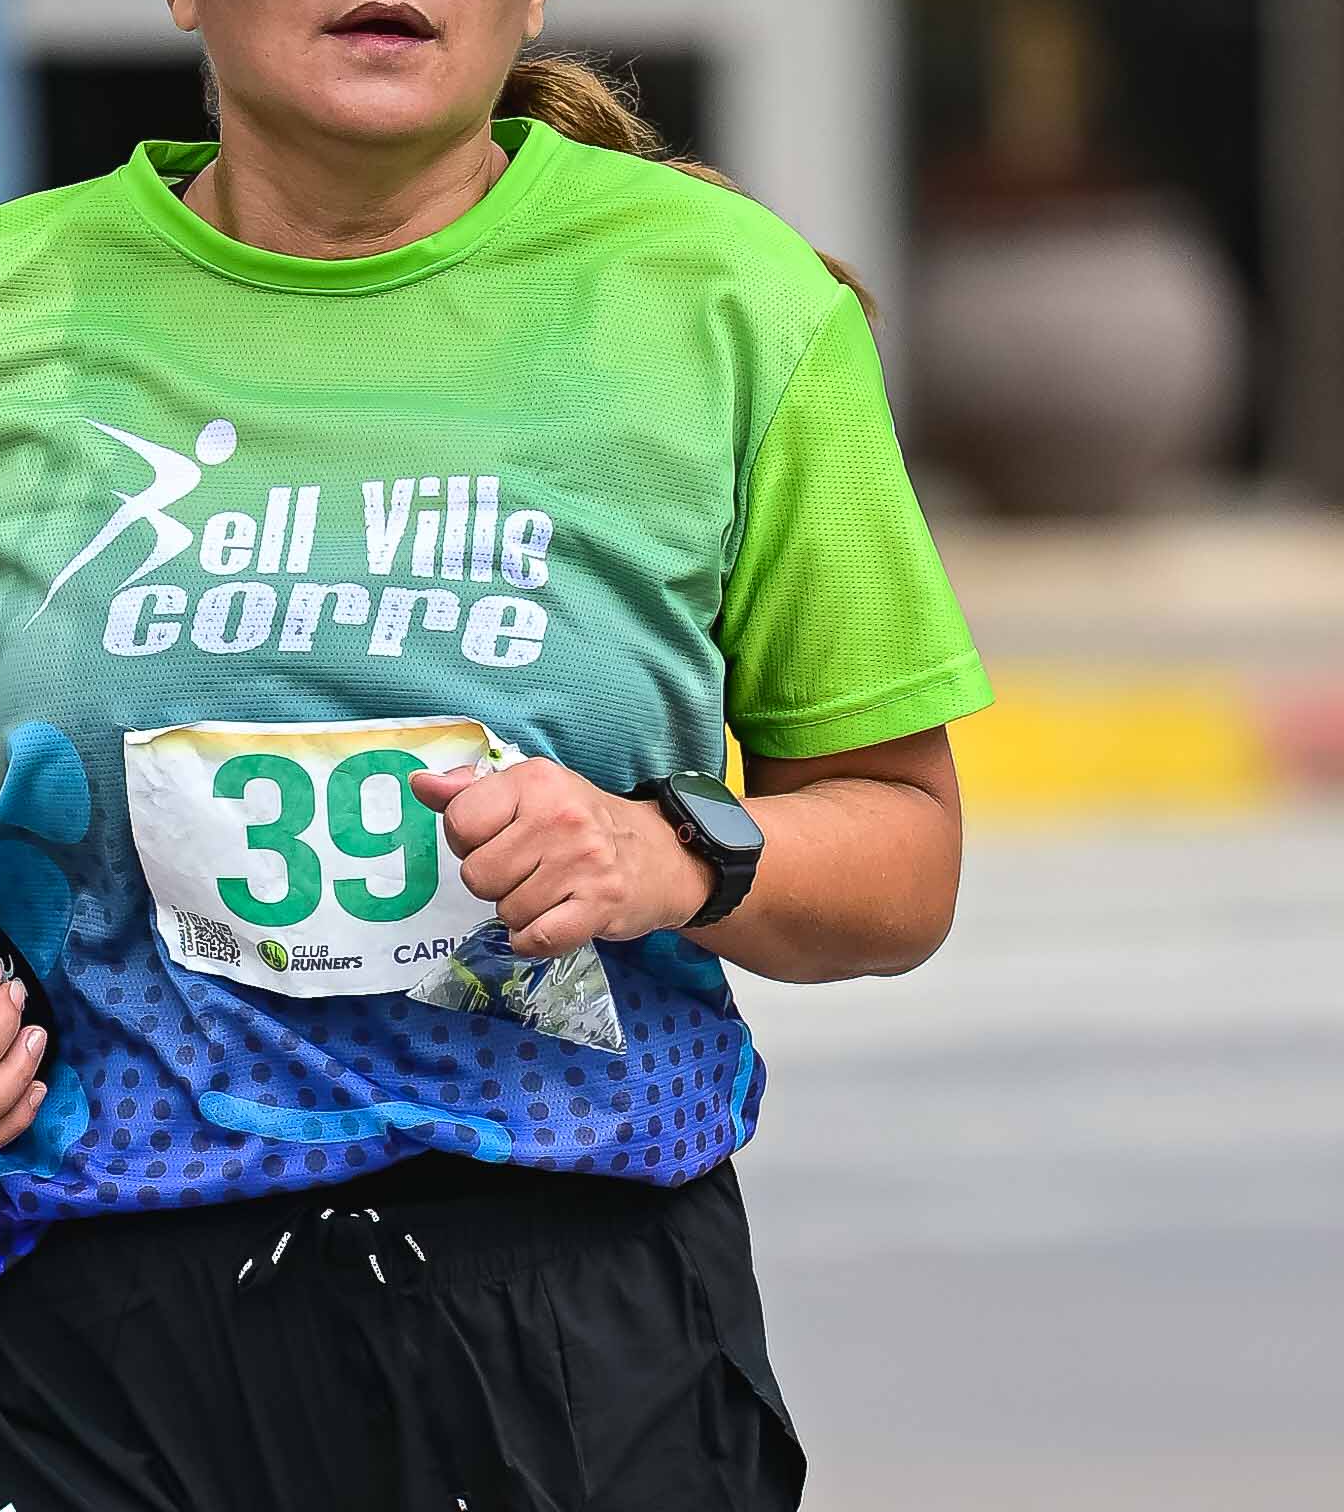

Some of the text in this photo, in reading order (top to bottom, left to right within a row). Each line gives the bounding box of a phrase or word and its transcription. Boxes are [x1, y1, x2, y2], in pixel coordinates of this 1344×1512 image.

[361, 475, 554, 589] Ville
[102, 581, 549, 667] corre
[213, 749, 441, 928] 39
[292, 945, 329, 958] CLUB
